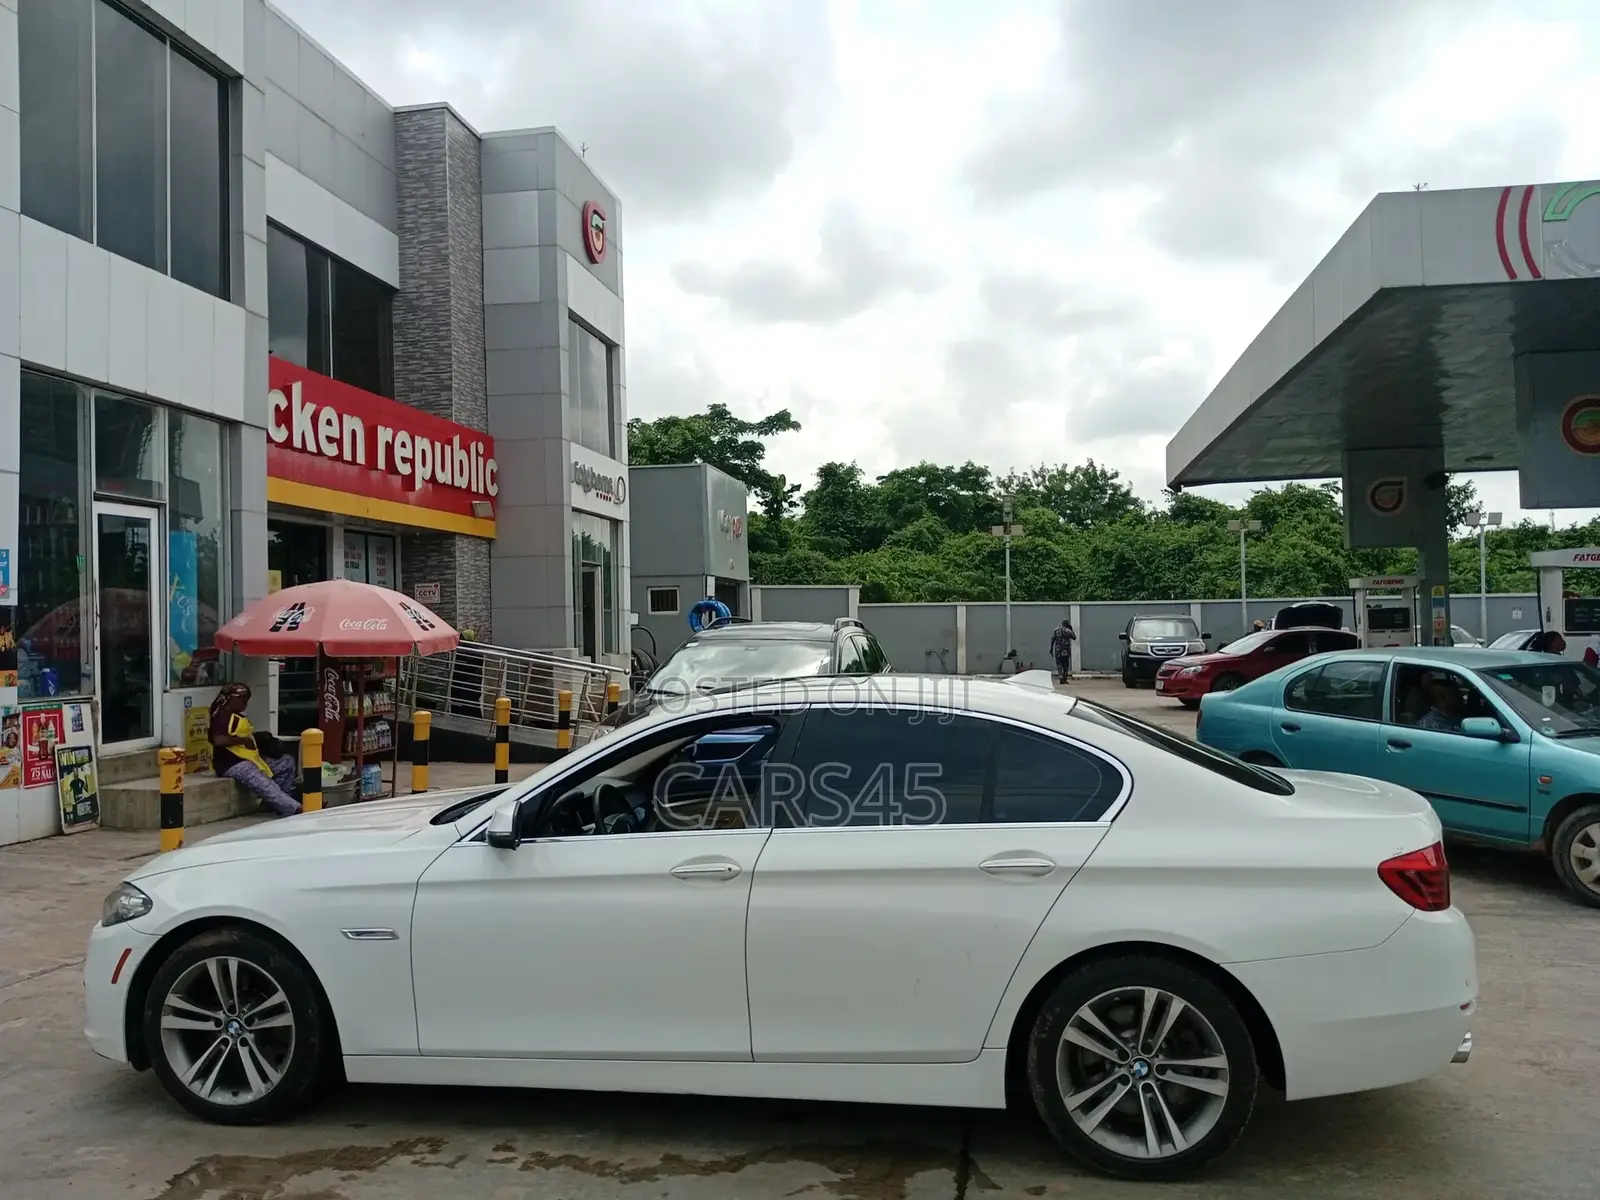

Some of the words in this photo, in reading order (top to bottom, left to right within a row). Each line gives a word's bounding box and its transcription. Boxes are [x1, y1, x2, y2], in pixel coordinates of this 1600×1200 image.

[377, 424, 499, 497] republic
[339, 618, 388, 631] Coca-Cola
[323, 667, 340, 724] Coca-Cola
[59, 751, 76, 766] WIN
